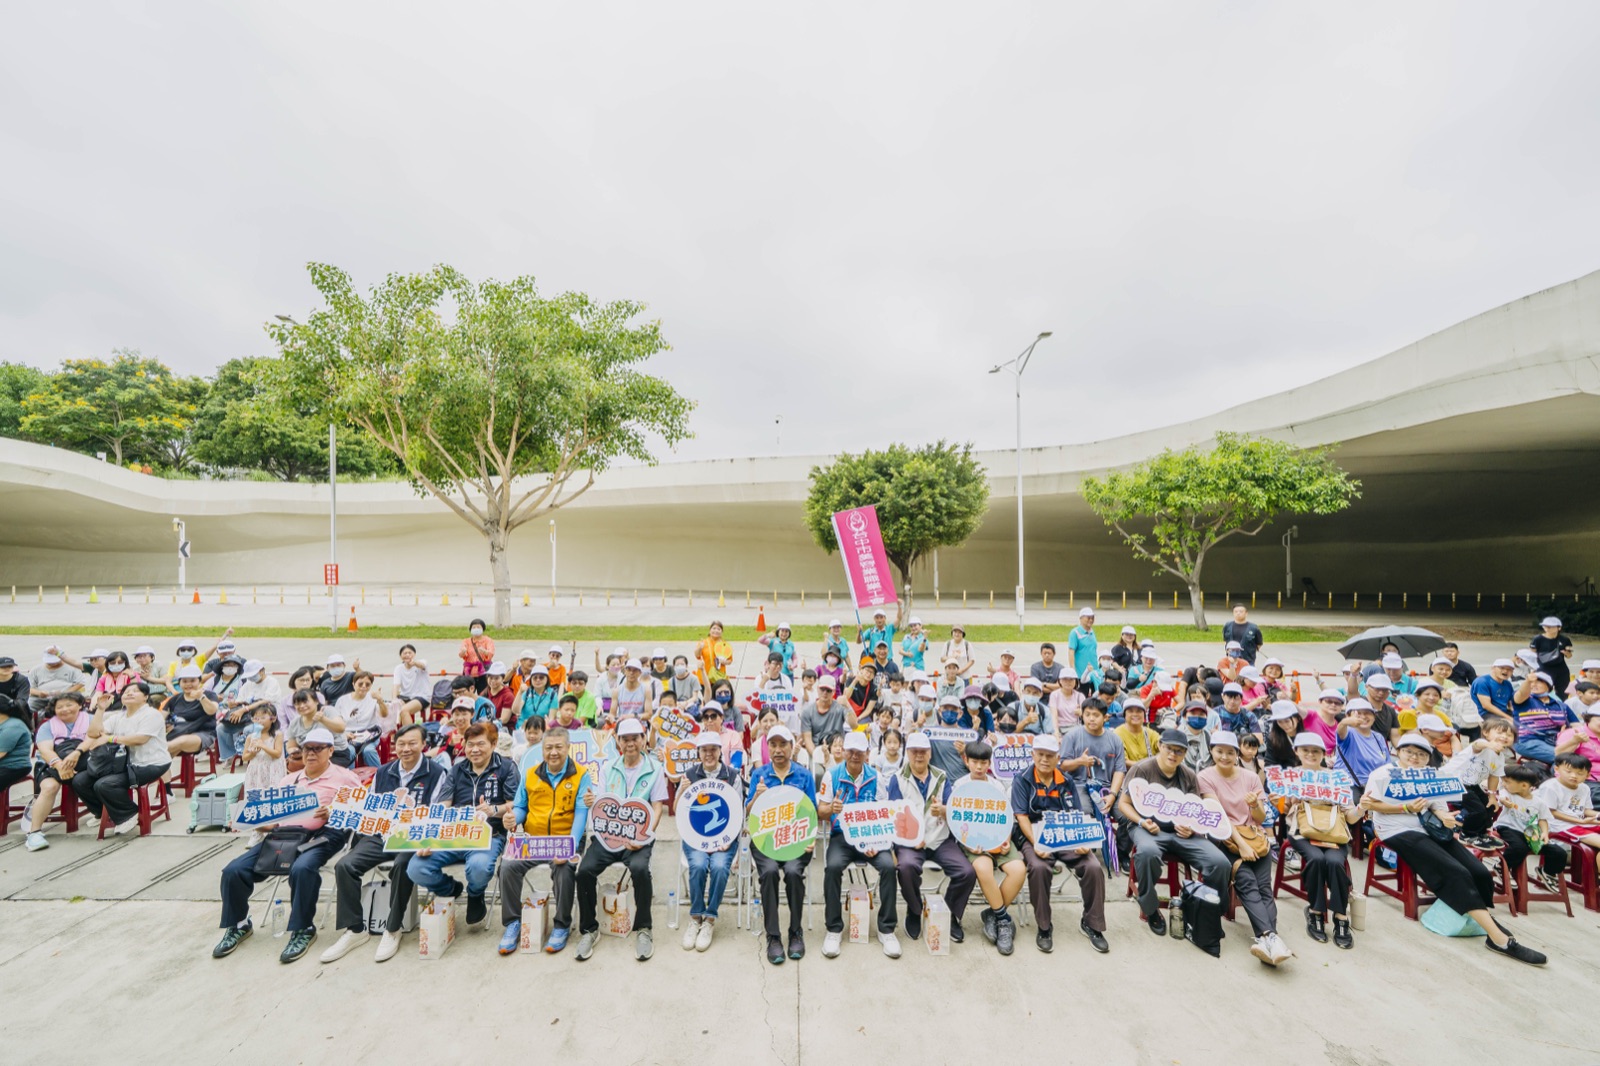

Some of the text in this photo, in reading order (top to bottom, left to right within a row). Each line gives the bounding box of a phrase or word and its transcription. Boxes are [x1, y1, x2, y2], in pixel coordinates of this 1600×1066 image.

[762, 703, 795, 711] 成就
[1267, 767, 1352, 786] 臺中健康走
[1389, 767, 1436, 780] 臺中市
[246, 785, 296, 802] 臺中市
[684, 781, 725, 801] 臺中市政府
[1269, 781, 1351, 804] 勞資逗陣行
[1388, 777, 1462, 798] 勞資健行活動
[243, 795, 317, 822] 勞資健行活動
[602, 802, 647, 824] 心世界
[952, 797, 1006, 811] 以行動支持
[1142, 791, 1221, 828] 健康樂活
[328, 809, 392, 835] 勞資逗陣
[399, 804, 475, 824] 臺中健康走
[760, 801, 795, 828] 逗陣
[843, 807, 890, 823] 共融職場
[952, 810, 1007, 825] 為努力加油
[1044, 811, 1083, 825] 臺中市
[408, 824, 483, 841] 勞資逗陣行
[593, 817, 636, 840] 無界限
[773, 818, 810, 848] 健行
[848, 822, 894, 839] 無礙前行
[1043, 827, 1103, 845] 勞資健行活動
[529, 838, 571, 847] 健康徒步走
[700, 835, 731, 850] 勞工局
[529, 847, 571, 857] 快樂伴我行
